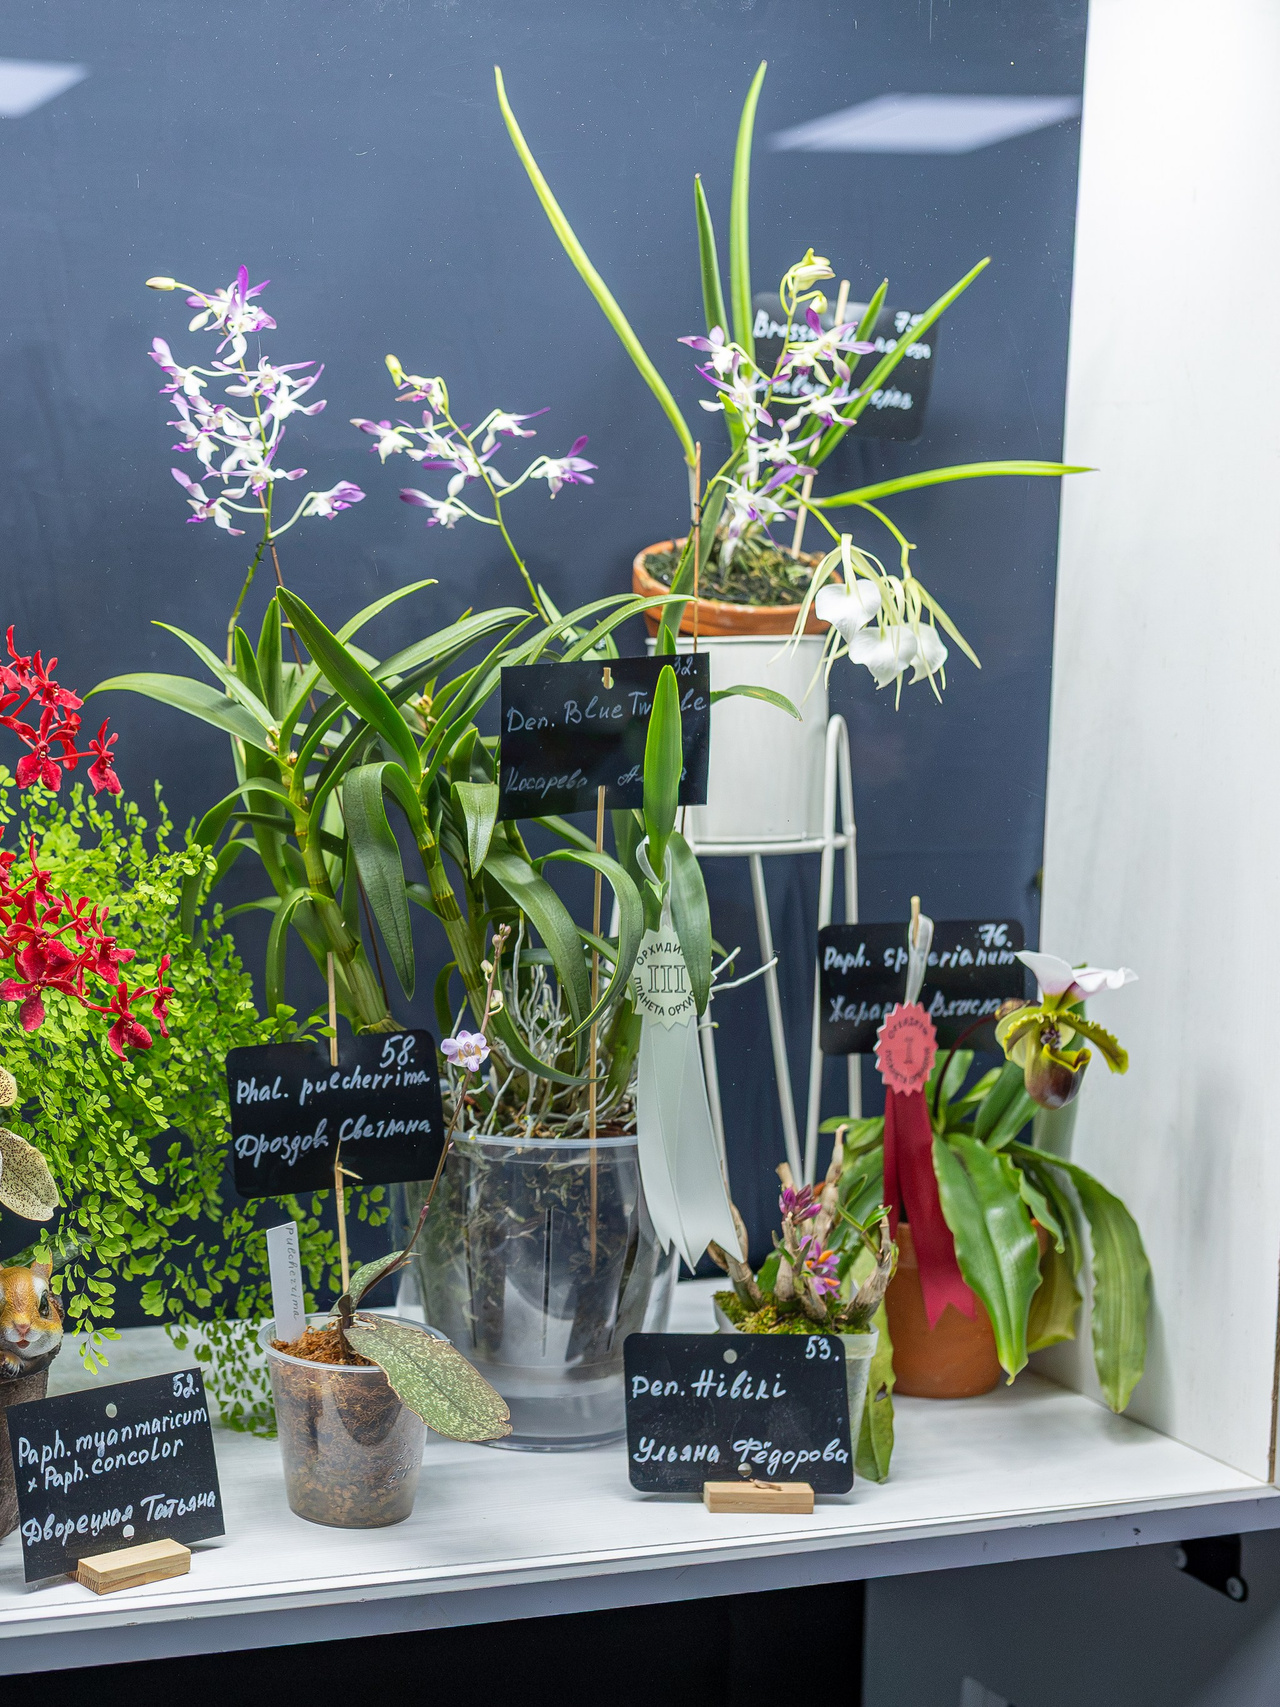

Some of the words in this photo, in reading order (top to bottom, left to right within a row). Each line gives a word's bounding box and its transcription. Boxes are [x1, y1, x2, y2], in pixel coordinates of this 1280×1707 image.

[507, 706, 554, 732] Den.
[564, 695, 623, 724] Blue
[636, 943, 684, 965] ОРХИДИ
[824, 943, 870, 975] Paph.
[884, 945, 1015, 973] sperianum
[634, 977, 664, 1016] ПЛАНЕТА
[647, 965, 686, 993] III
[237, 1076, 288, 1104] Phal.
[299, 1065, 430, 1106] pulcherrima
[339, 1114, 431, 1141] Светлана
[632, 1375, 685, 1398] Den.
[19, 1430, 71, 1473] Paph.
[76, 1407, 207, 1457] myanmaricum
[633, 1437, 720, 1463] Ульяна
[733, 1438, 848, 1476] Фёдорова
[45, 1460, 88, 1493] Paph.
[92, 1437, 184, 1475] concolor
[22, 1505, 133, 1546] Дворецкая
[140, 1491, 216, 1521] Татьяна
